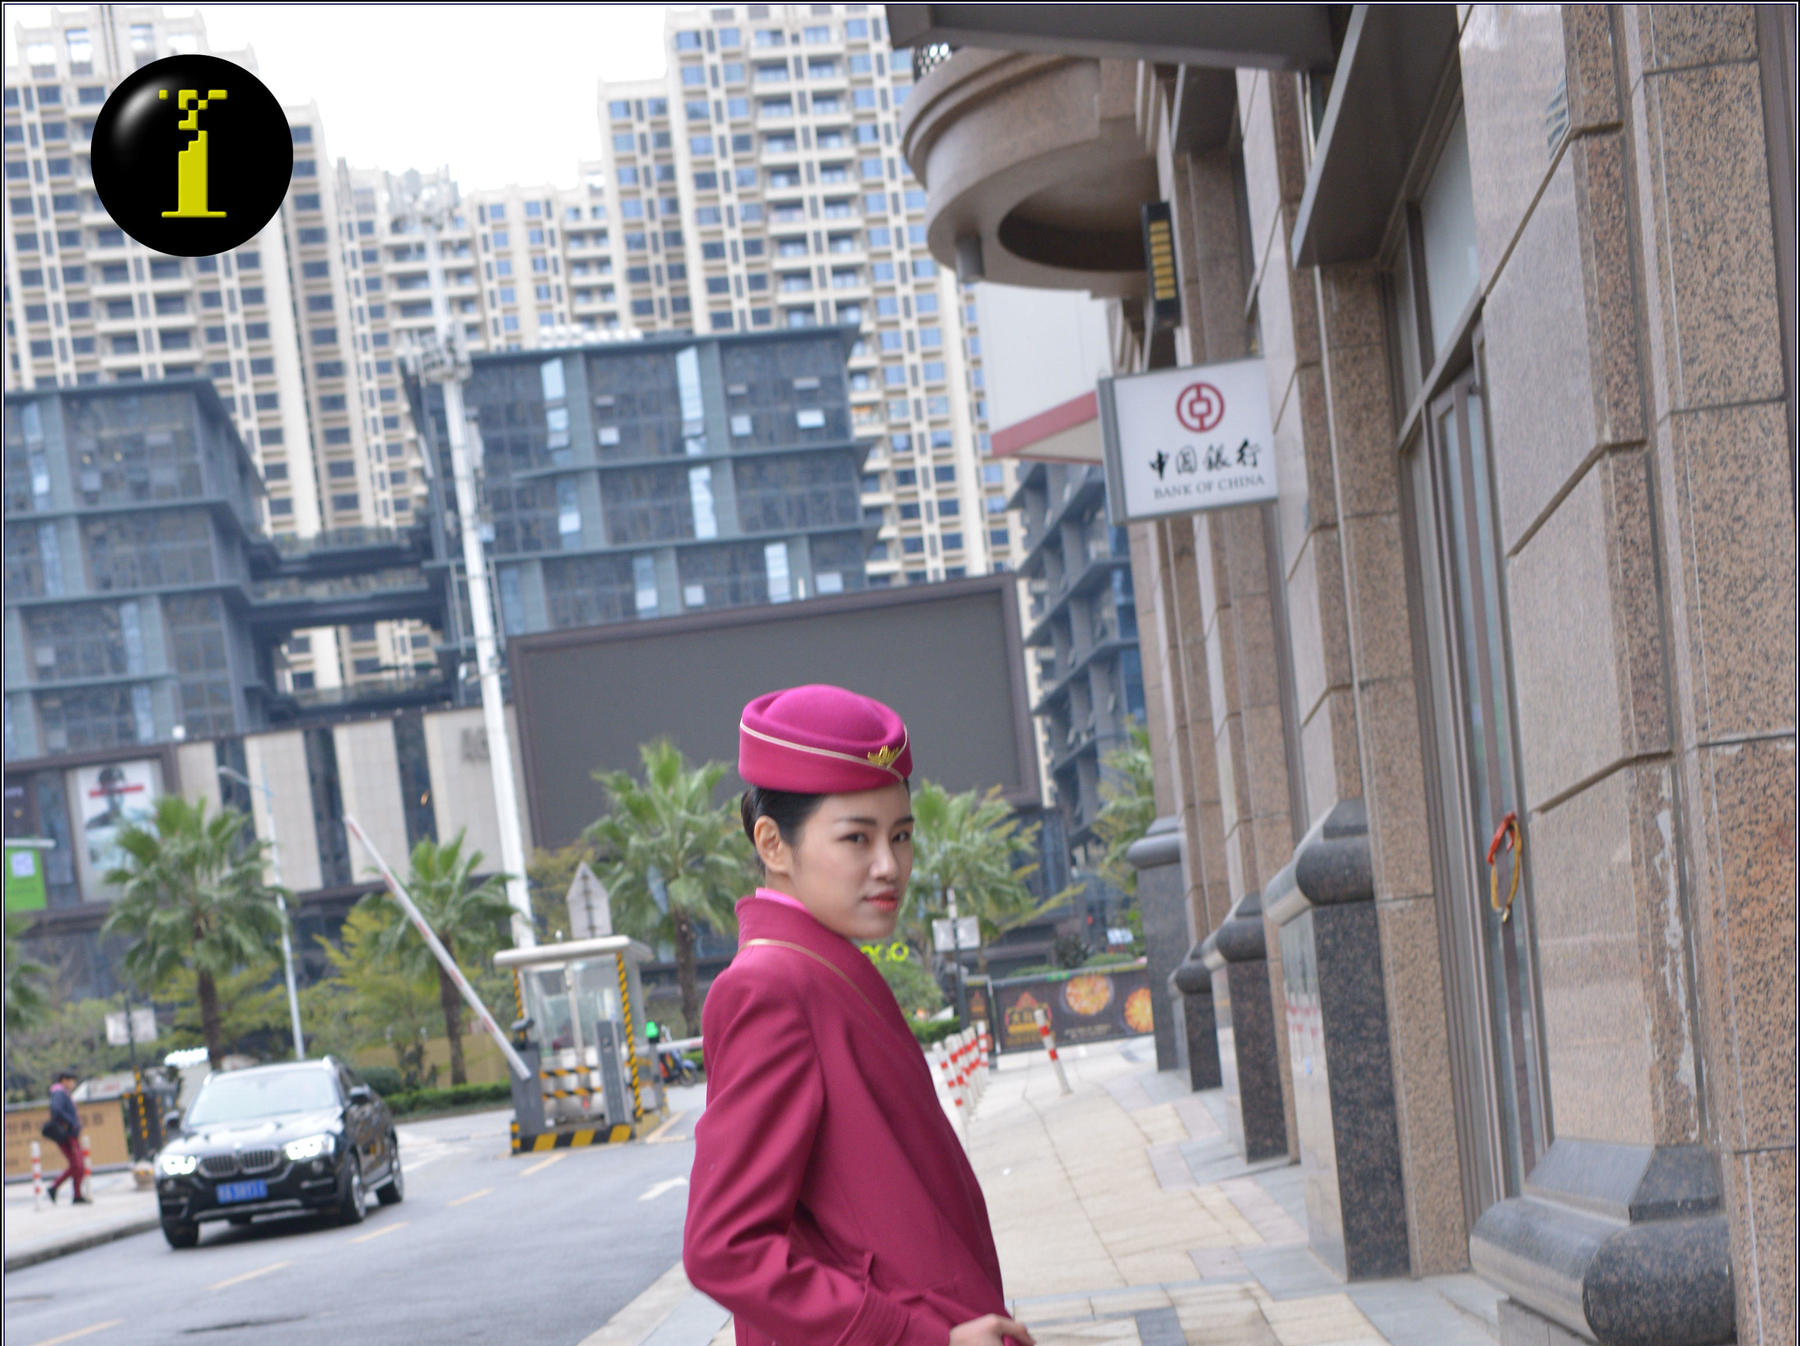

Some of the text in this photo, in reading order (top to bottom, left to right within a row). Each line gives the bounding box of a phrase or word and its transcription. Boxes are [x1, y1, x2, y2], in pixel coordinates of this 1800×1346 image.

[1153, 474, 1265, 499] BANK OF CHINA
